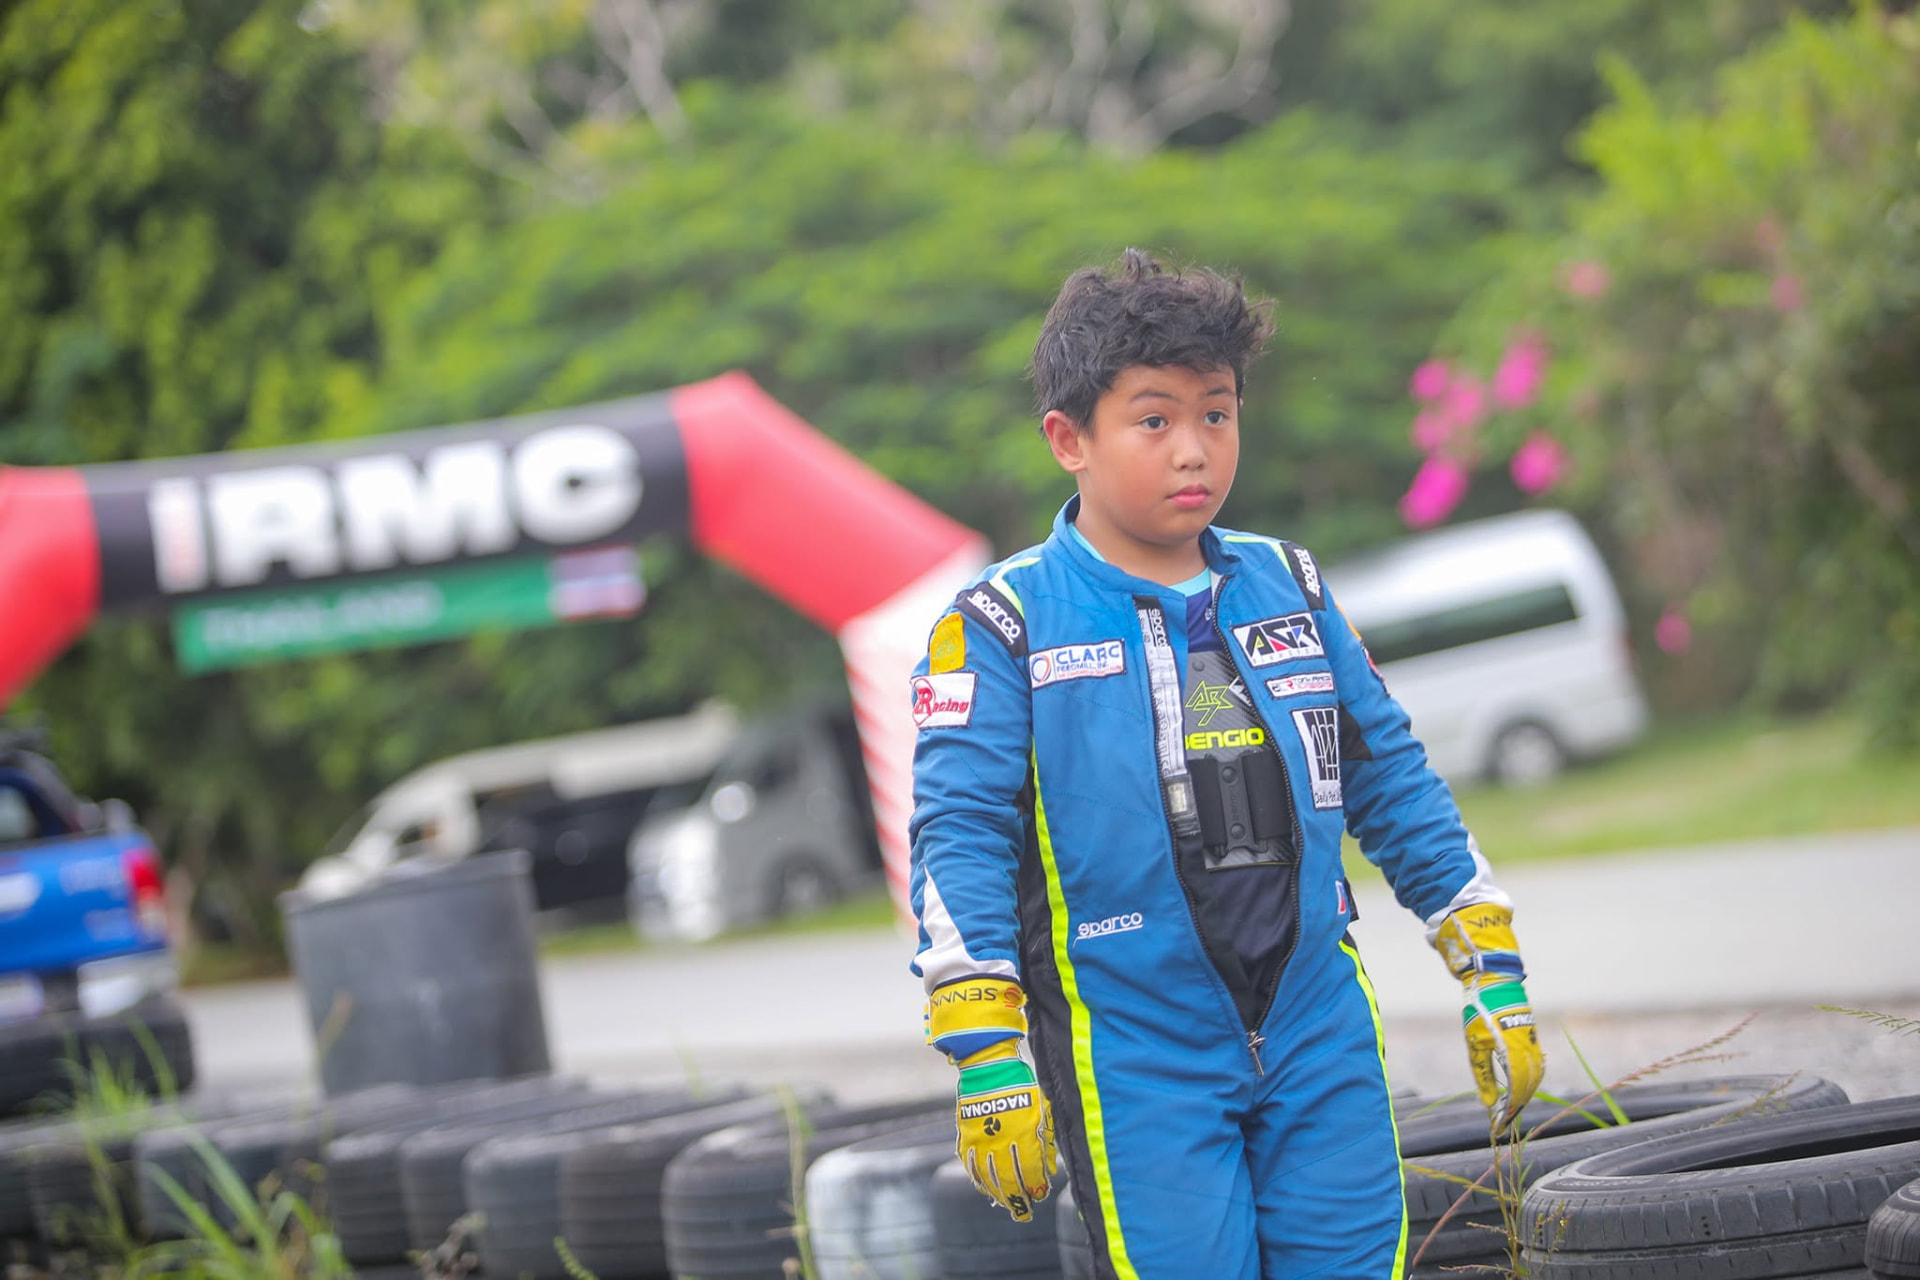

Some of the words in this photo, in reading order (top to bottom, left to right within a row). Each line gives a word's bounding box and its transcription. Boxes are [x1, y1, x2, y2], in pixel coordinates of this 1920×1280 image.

[967, 590, 1021, 645] sparco
[1055, 644, 1120, 665] CLARC
[1184, 727, 1265, 750] ENGIO
[1072, 912, 1144, 948] sparco
